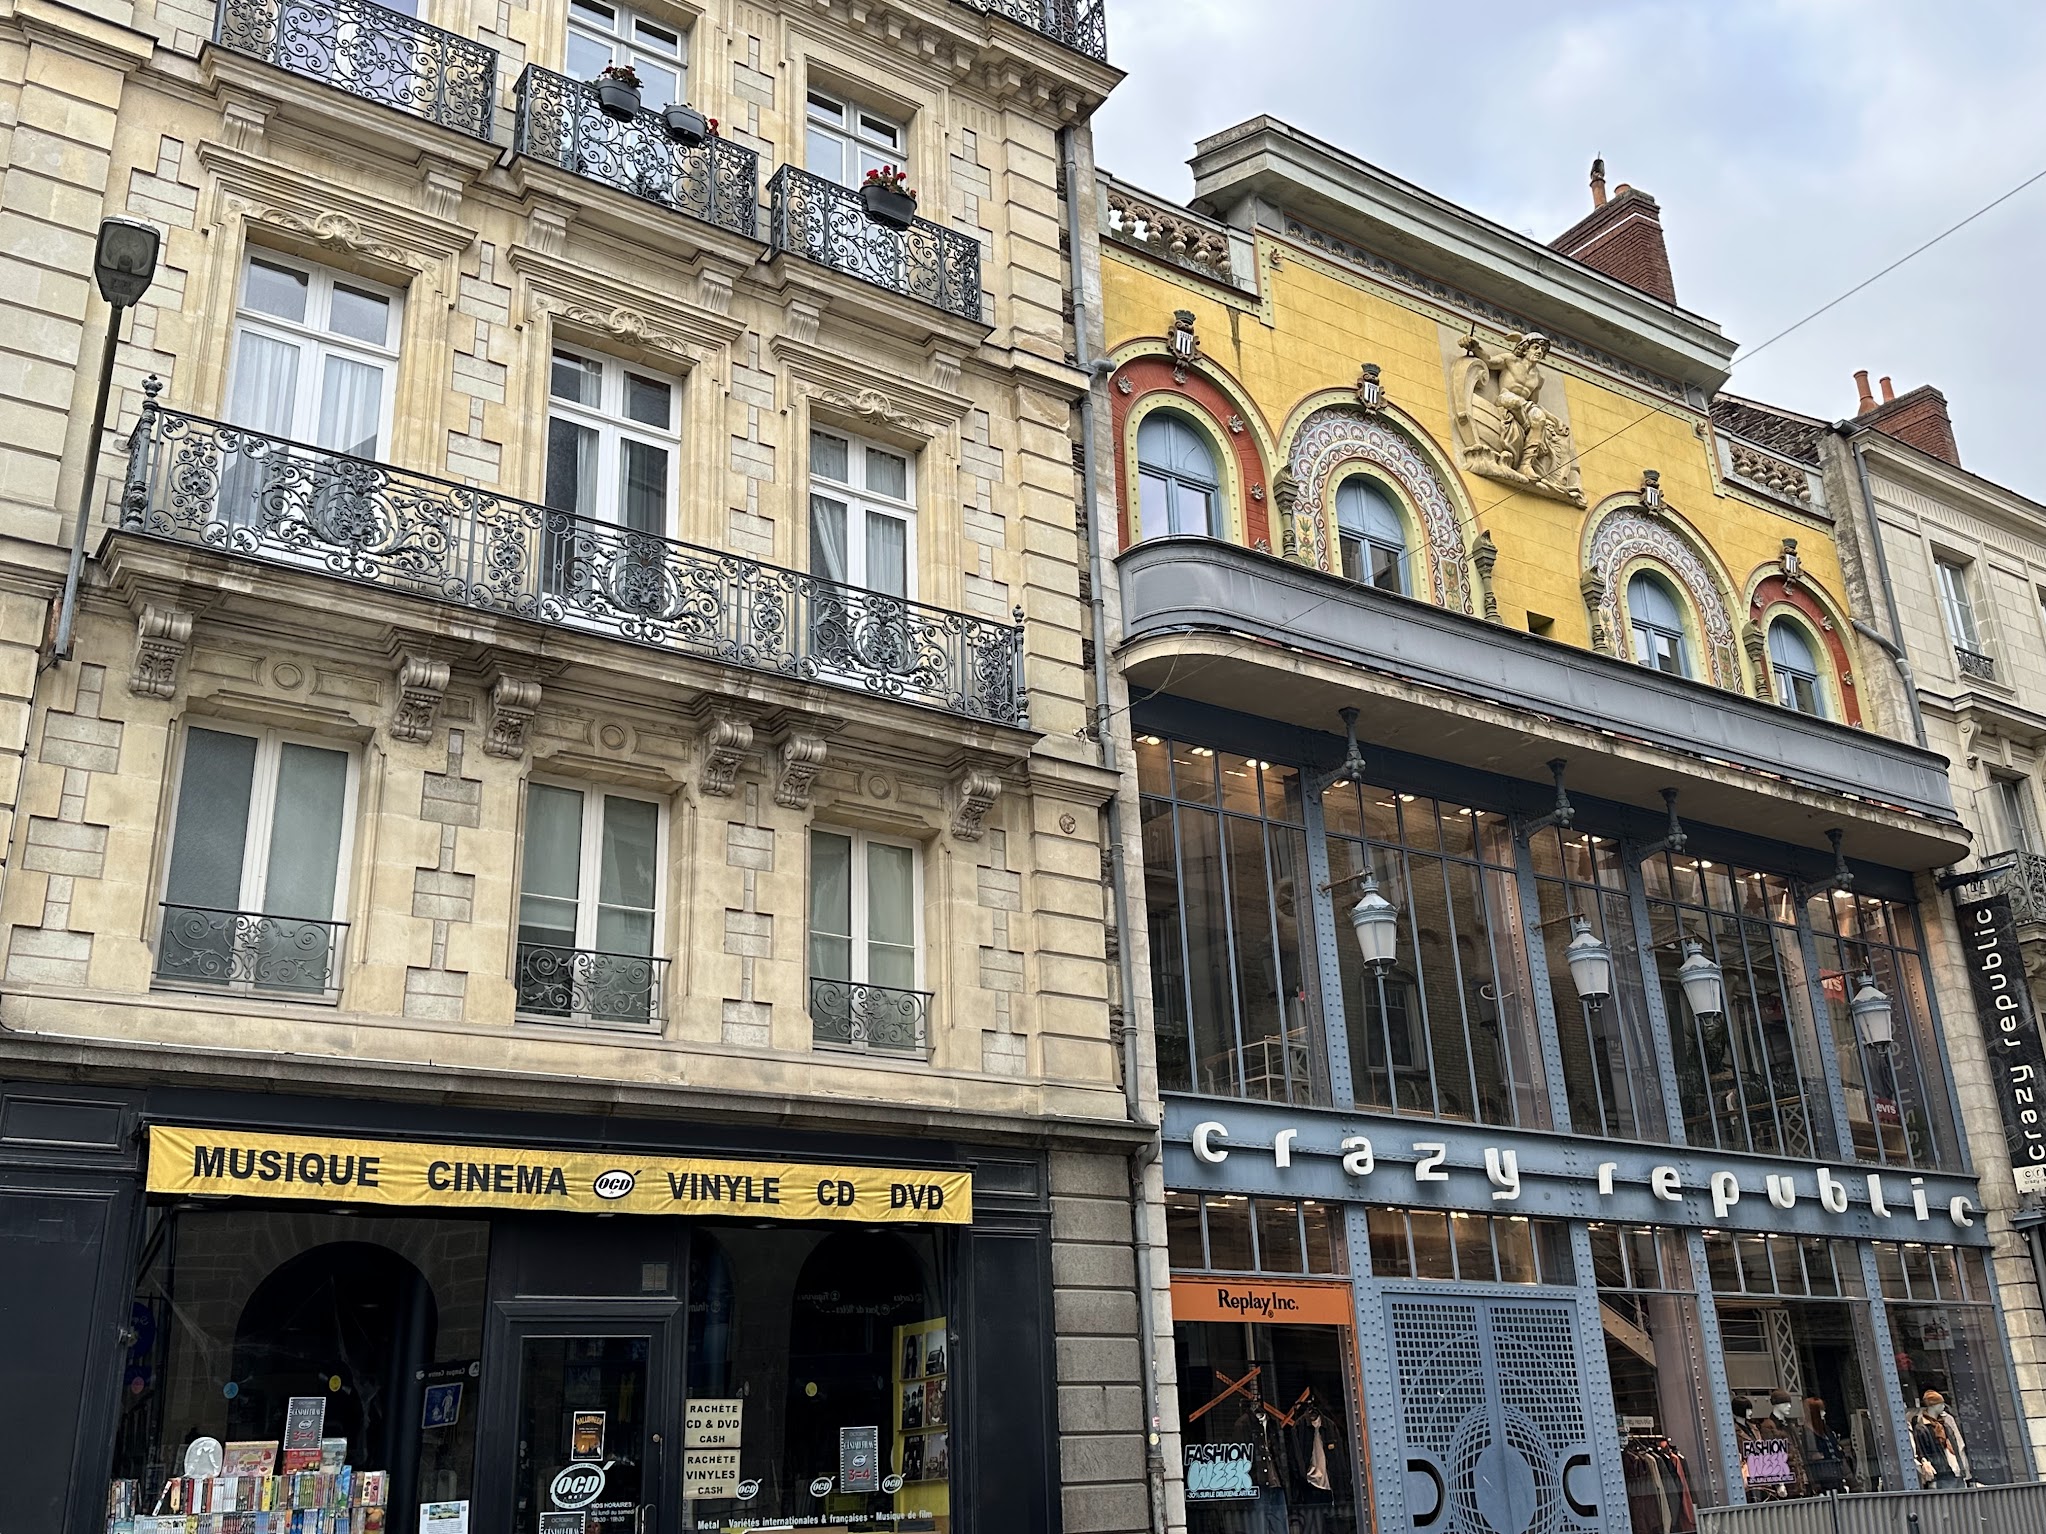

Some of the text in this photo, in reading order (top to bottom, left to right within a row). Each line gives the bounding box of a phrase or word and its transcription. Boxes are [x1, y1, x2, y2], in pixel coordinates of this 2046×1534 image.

[1974, 908, 2046, 1161] crazy republic
[193, 1146, 380, 1187] MUSIQUE
[427, 1160, 568, 1196] CINEMA
[667, 1172, 780, 1204] VINYLE
[817, 1179, 855, 1207] CD
[890, 1183, 944, 1210] DVD
[1192, 1121, 1973, 1228] crazy republic
[1217, 1288, 1299, 1316] Replay Inc.
[690, 1404, 738, 1413] RACHÈTE
[686, 1420, 739, 1428] CD & DVD
[1184, 1443, 1254, 1466] FASHION
[1743, 1438, 1788, 1458] FASHION
[687, 1454, 736, 1464] RACHÈTE
[1747, 1451, 1790, 1478] WEEK
[686, 1471, 736, 1480] VINYLES
[848, 1468, 871, 1481] 3=4
[1187, 1458, 1252, 1492] WEEK
[557, 1476, 600, 1494] OCD
[698, 1520, 719, 1530] Metal
[729, 1518, 760, 1528] Variétés
[763, 1515, 818, 1526] internationales
[821, 1514, 827, 1524] &
[830, 1513, 868, 1524] françaises
[876, 1511, 905, 1521] Musique
[907, 1510, 916, 1519] de
[919, 1510, 933, 1519] film
